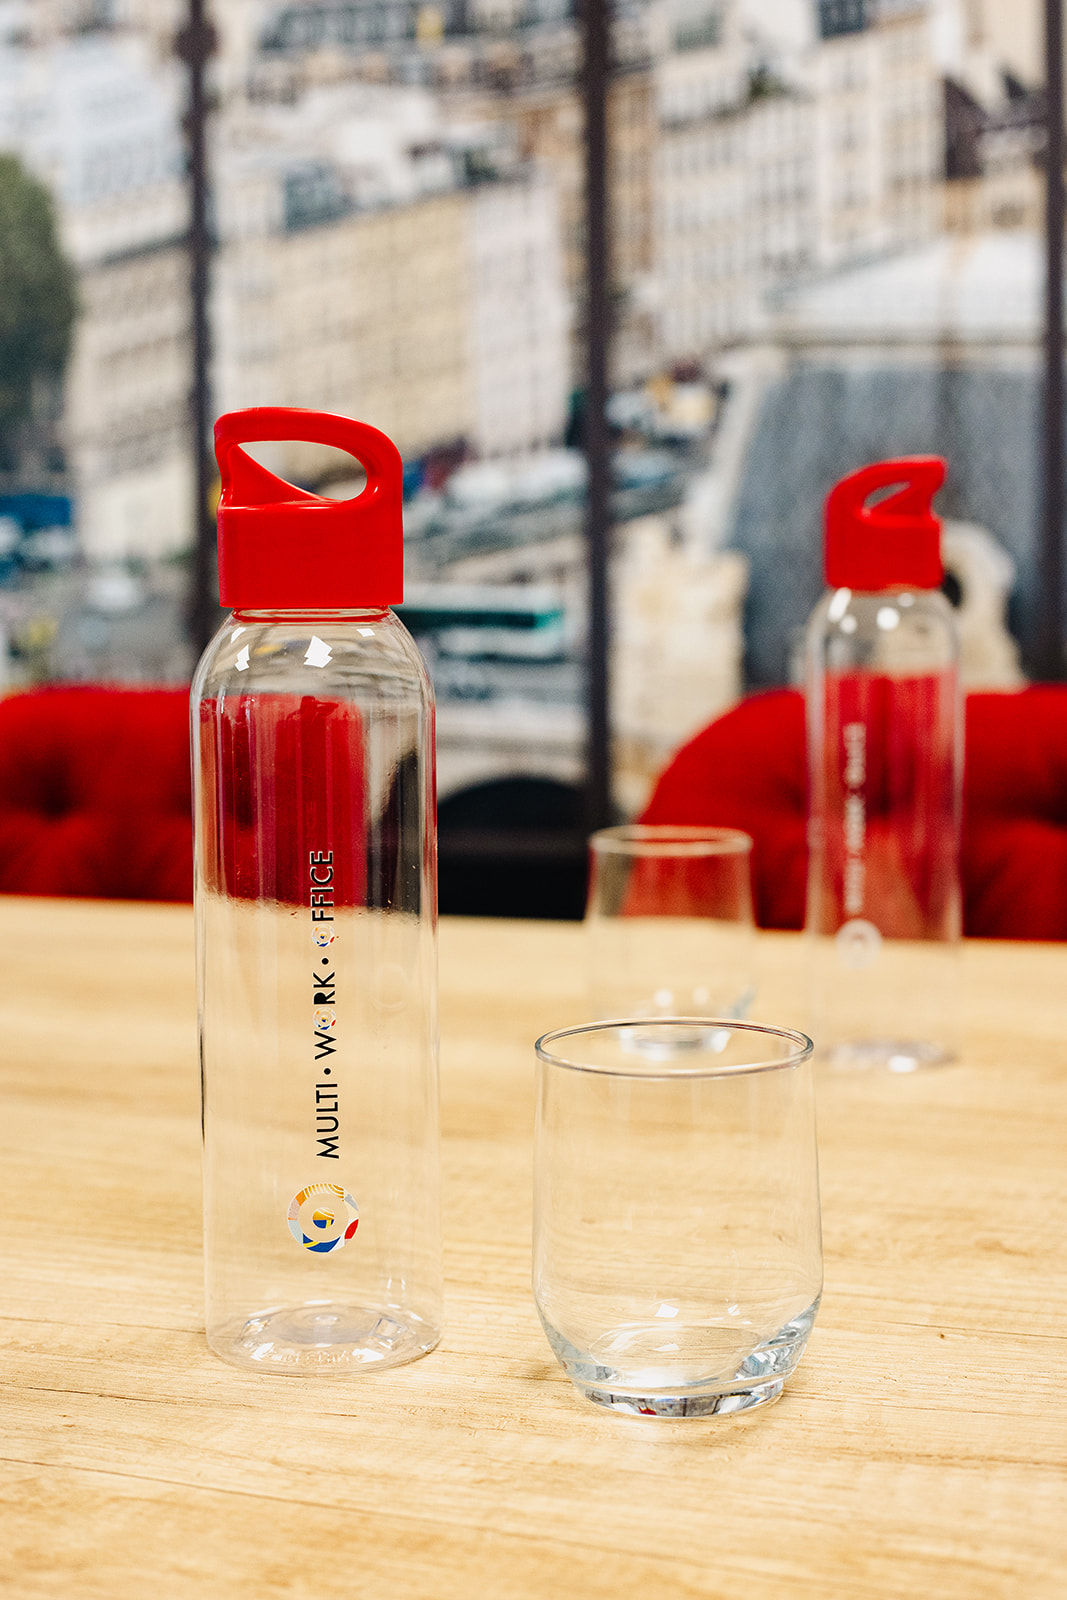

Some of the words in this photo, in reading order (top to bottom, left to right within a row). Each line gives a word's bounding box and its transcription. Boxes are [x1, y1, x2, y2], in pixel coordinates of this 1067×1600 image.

[310, 850, 335, 947] OFFICE
[313, 971, 337, 1060] WORK
[316, 1083, 340, 1159] MULTI
